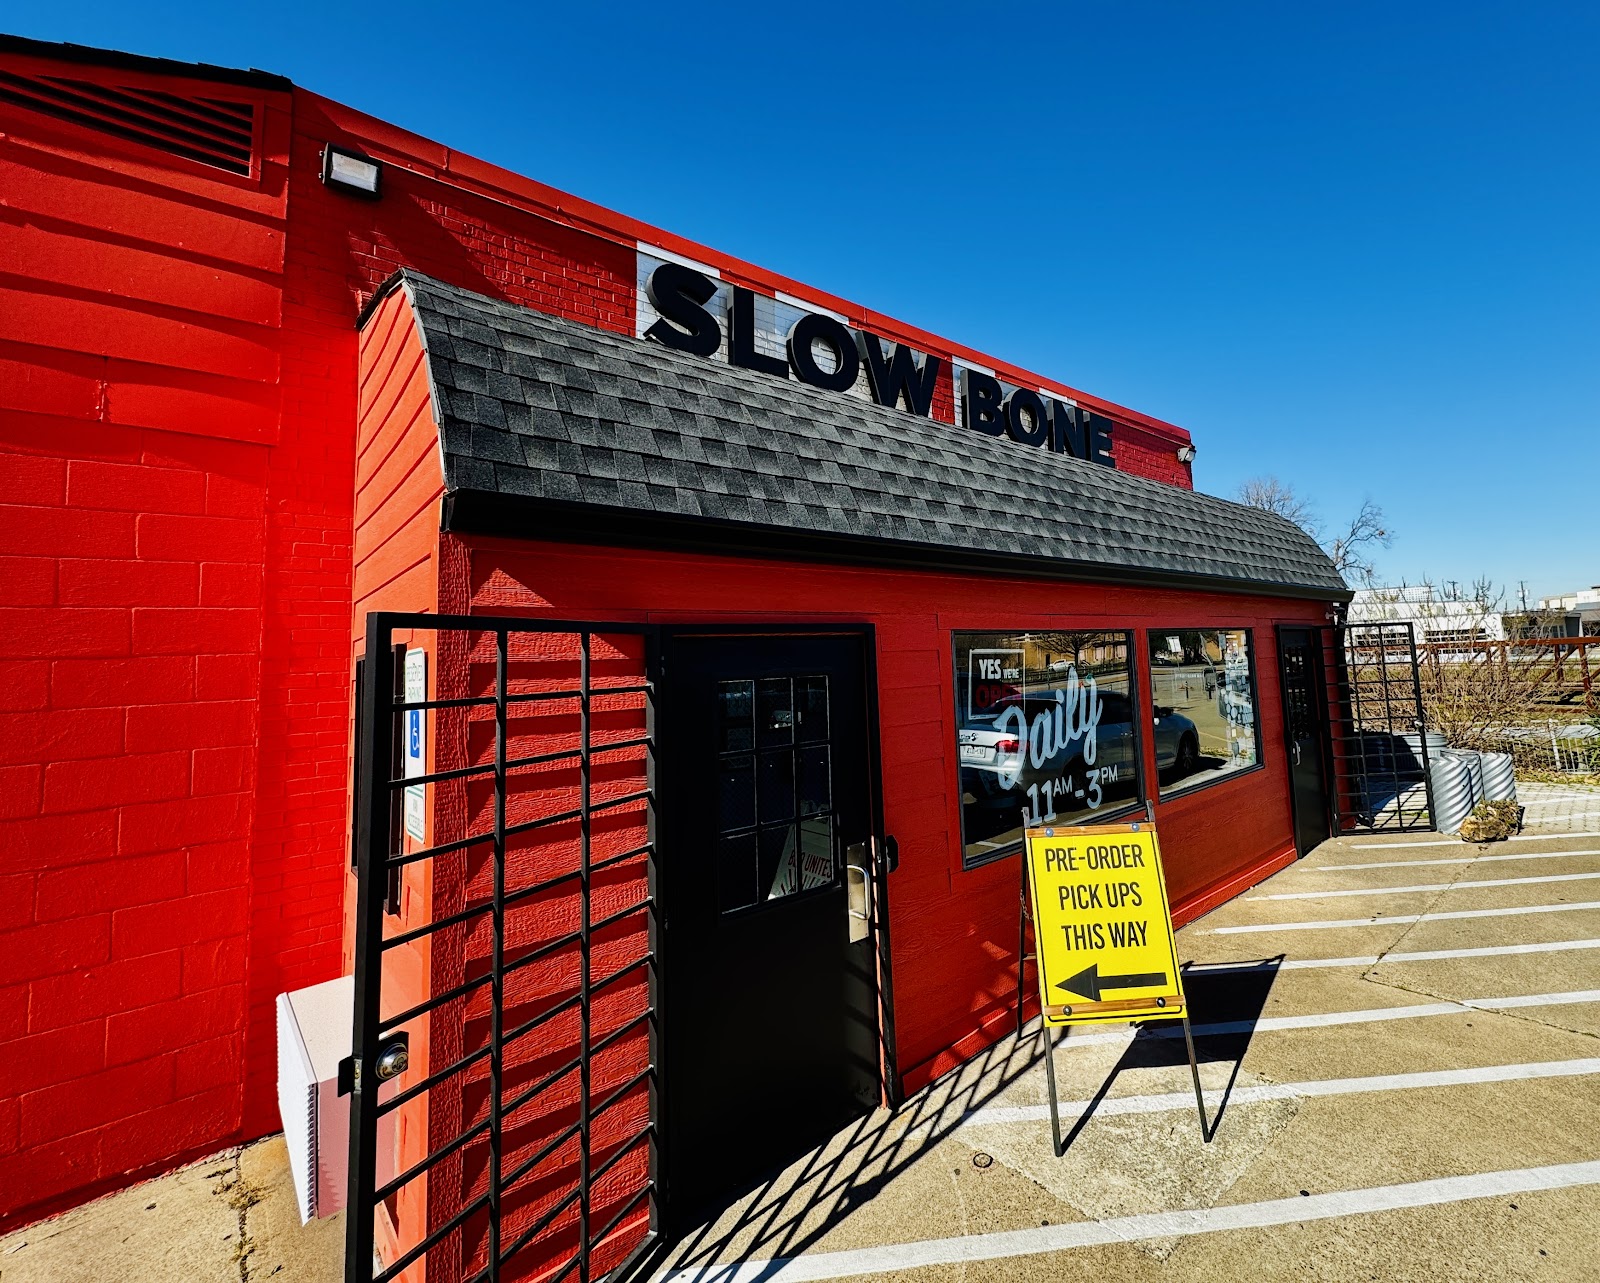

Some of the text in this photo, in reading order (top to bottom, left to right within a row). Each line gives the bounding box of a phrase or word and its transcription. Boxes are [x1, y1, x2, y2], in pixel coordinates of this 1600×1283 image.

[643, 263, 1116, 468] SLOW BONE
[978, 658, 1002, 680] YES
[993, 666, 1103, 791] Daily
[1045, 844, 1145, 872] PRE-ORDER
[1058, 881, 1143, 910] PICK UPS
[1061, 920, 1148, 951] THIS WAY
